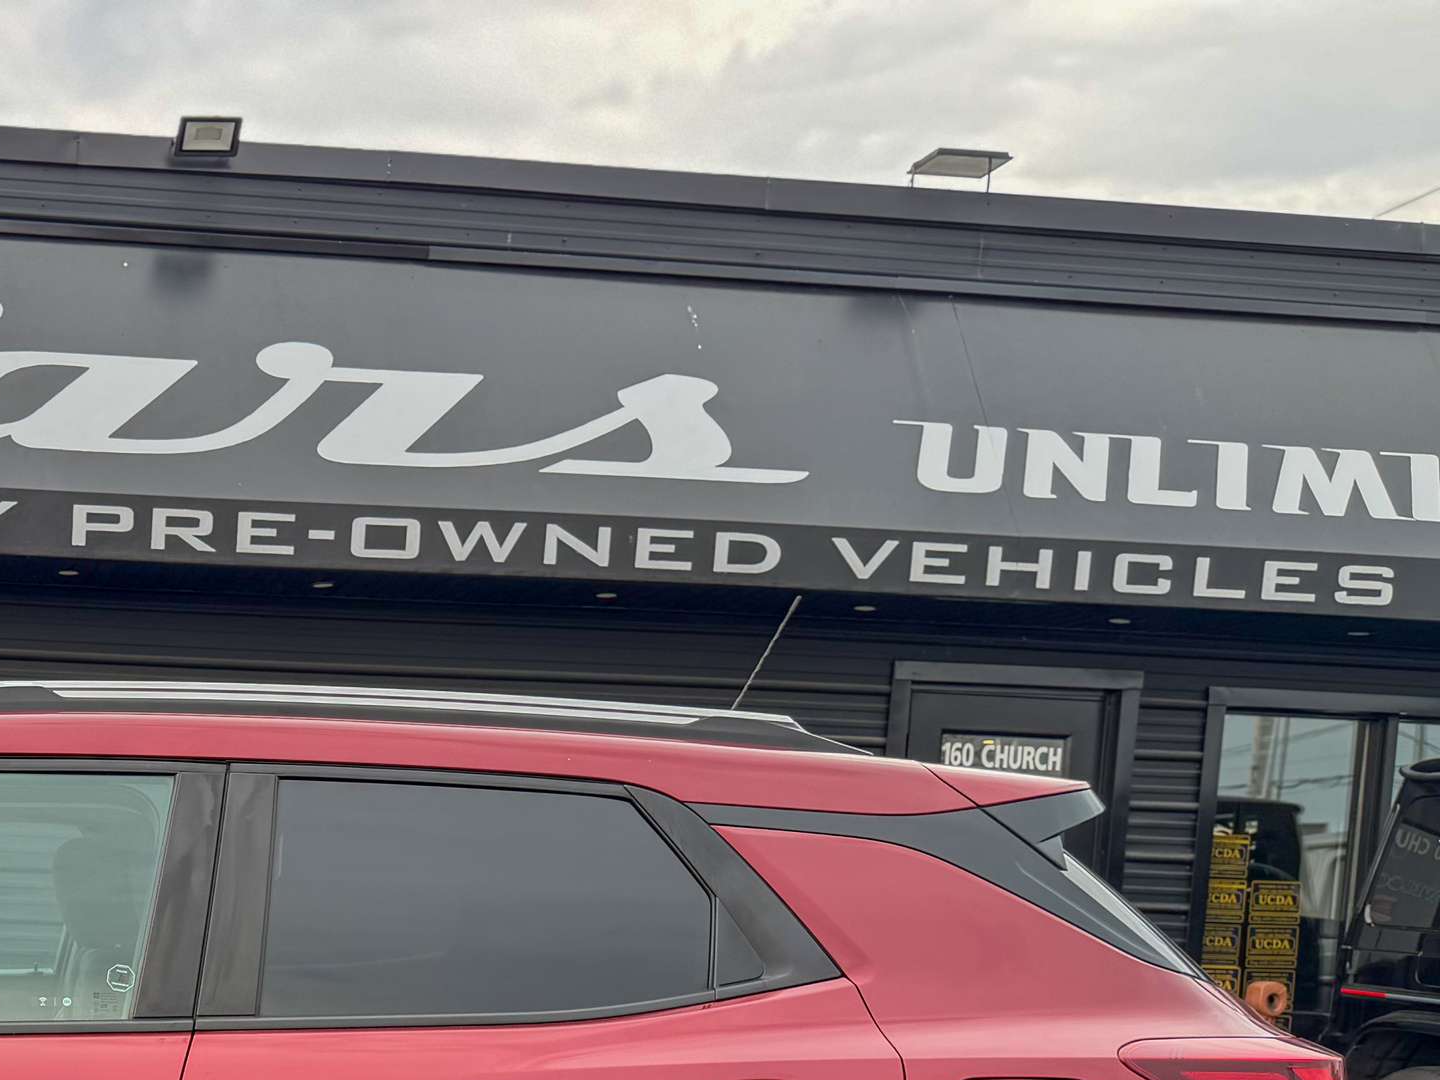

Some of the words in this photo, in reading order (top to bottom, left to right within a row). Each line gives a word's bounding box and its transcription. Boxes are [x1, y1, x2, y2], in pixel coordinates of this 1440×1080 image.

[72, 505, 781, 573] PRE-OWNED
[832, 538, 1394, 605] VEHICLES
[942, 742, 974, 766] 160
[981, 744, 1062, 771] CHURCH
[1213, 848, 1241, 858] CDA
[1210, 893, 1237, 904] CDA
[1259, 894, 1294, 906] UCDA
[1204, 936, 1232, 946] CDA
[1255, 938, 1290, 950] UCDA
